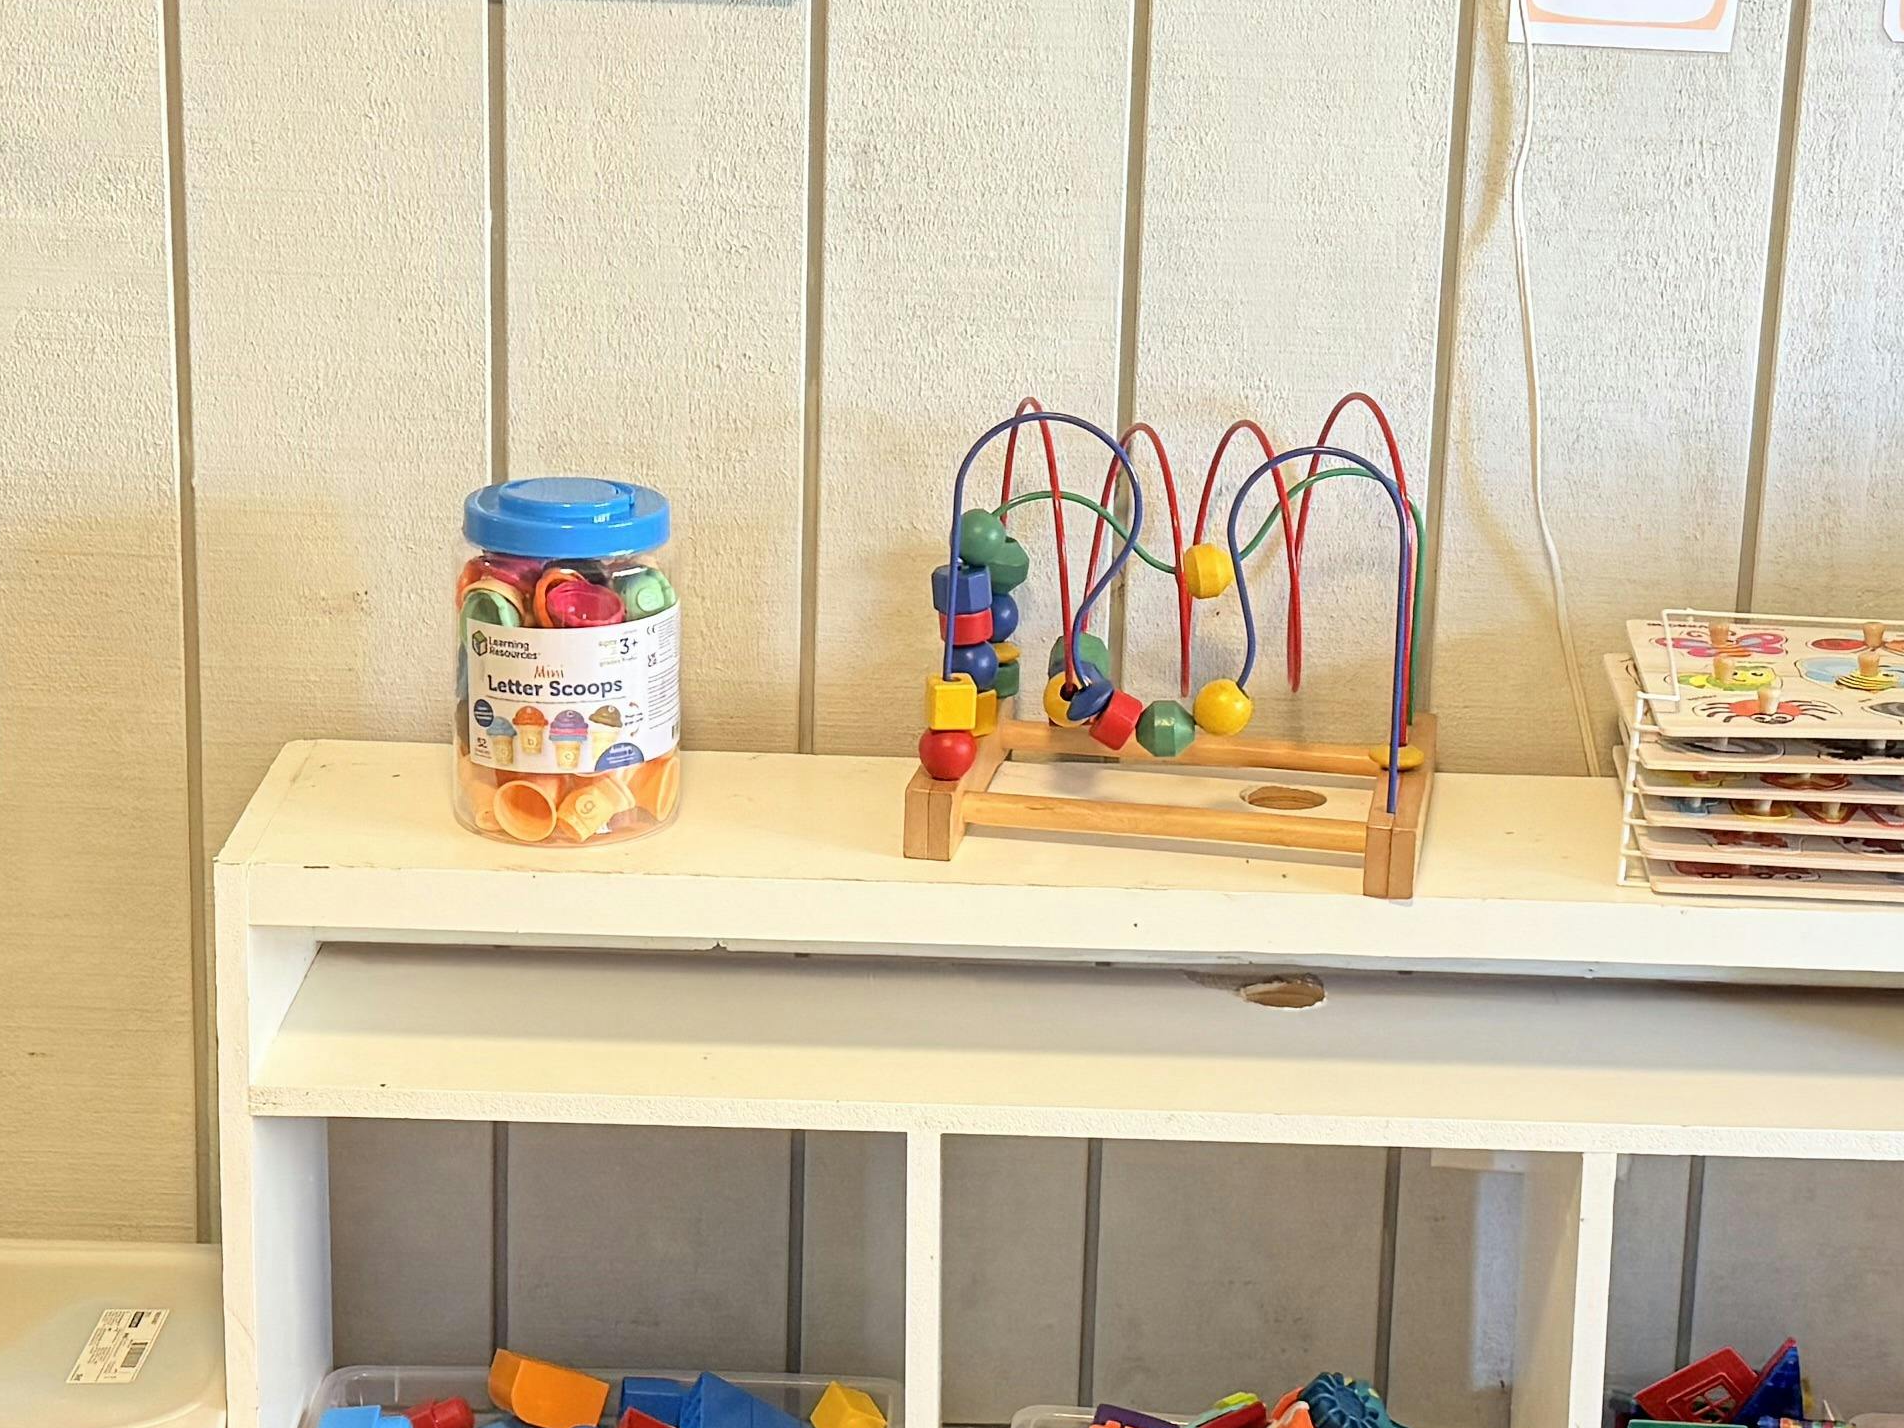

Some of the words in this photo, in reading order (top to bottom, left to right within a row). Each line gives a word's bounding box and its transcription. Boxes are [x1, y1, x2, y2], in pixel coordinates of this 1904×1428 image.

[488, 635, 530, 652] Learning
[619, 637, 639, 655] 3+
[489, 647, 538, 660] Resources
[534, 664, 564, 679] Mini
[487, 674, 543, 697] Letter
[549, 678, 623, 699] Scoops
